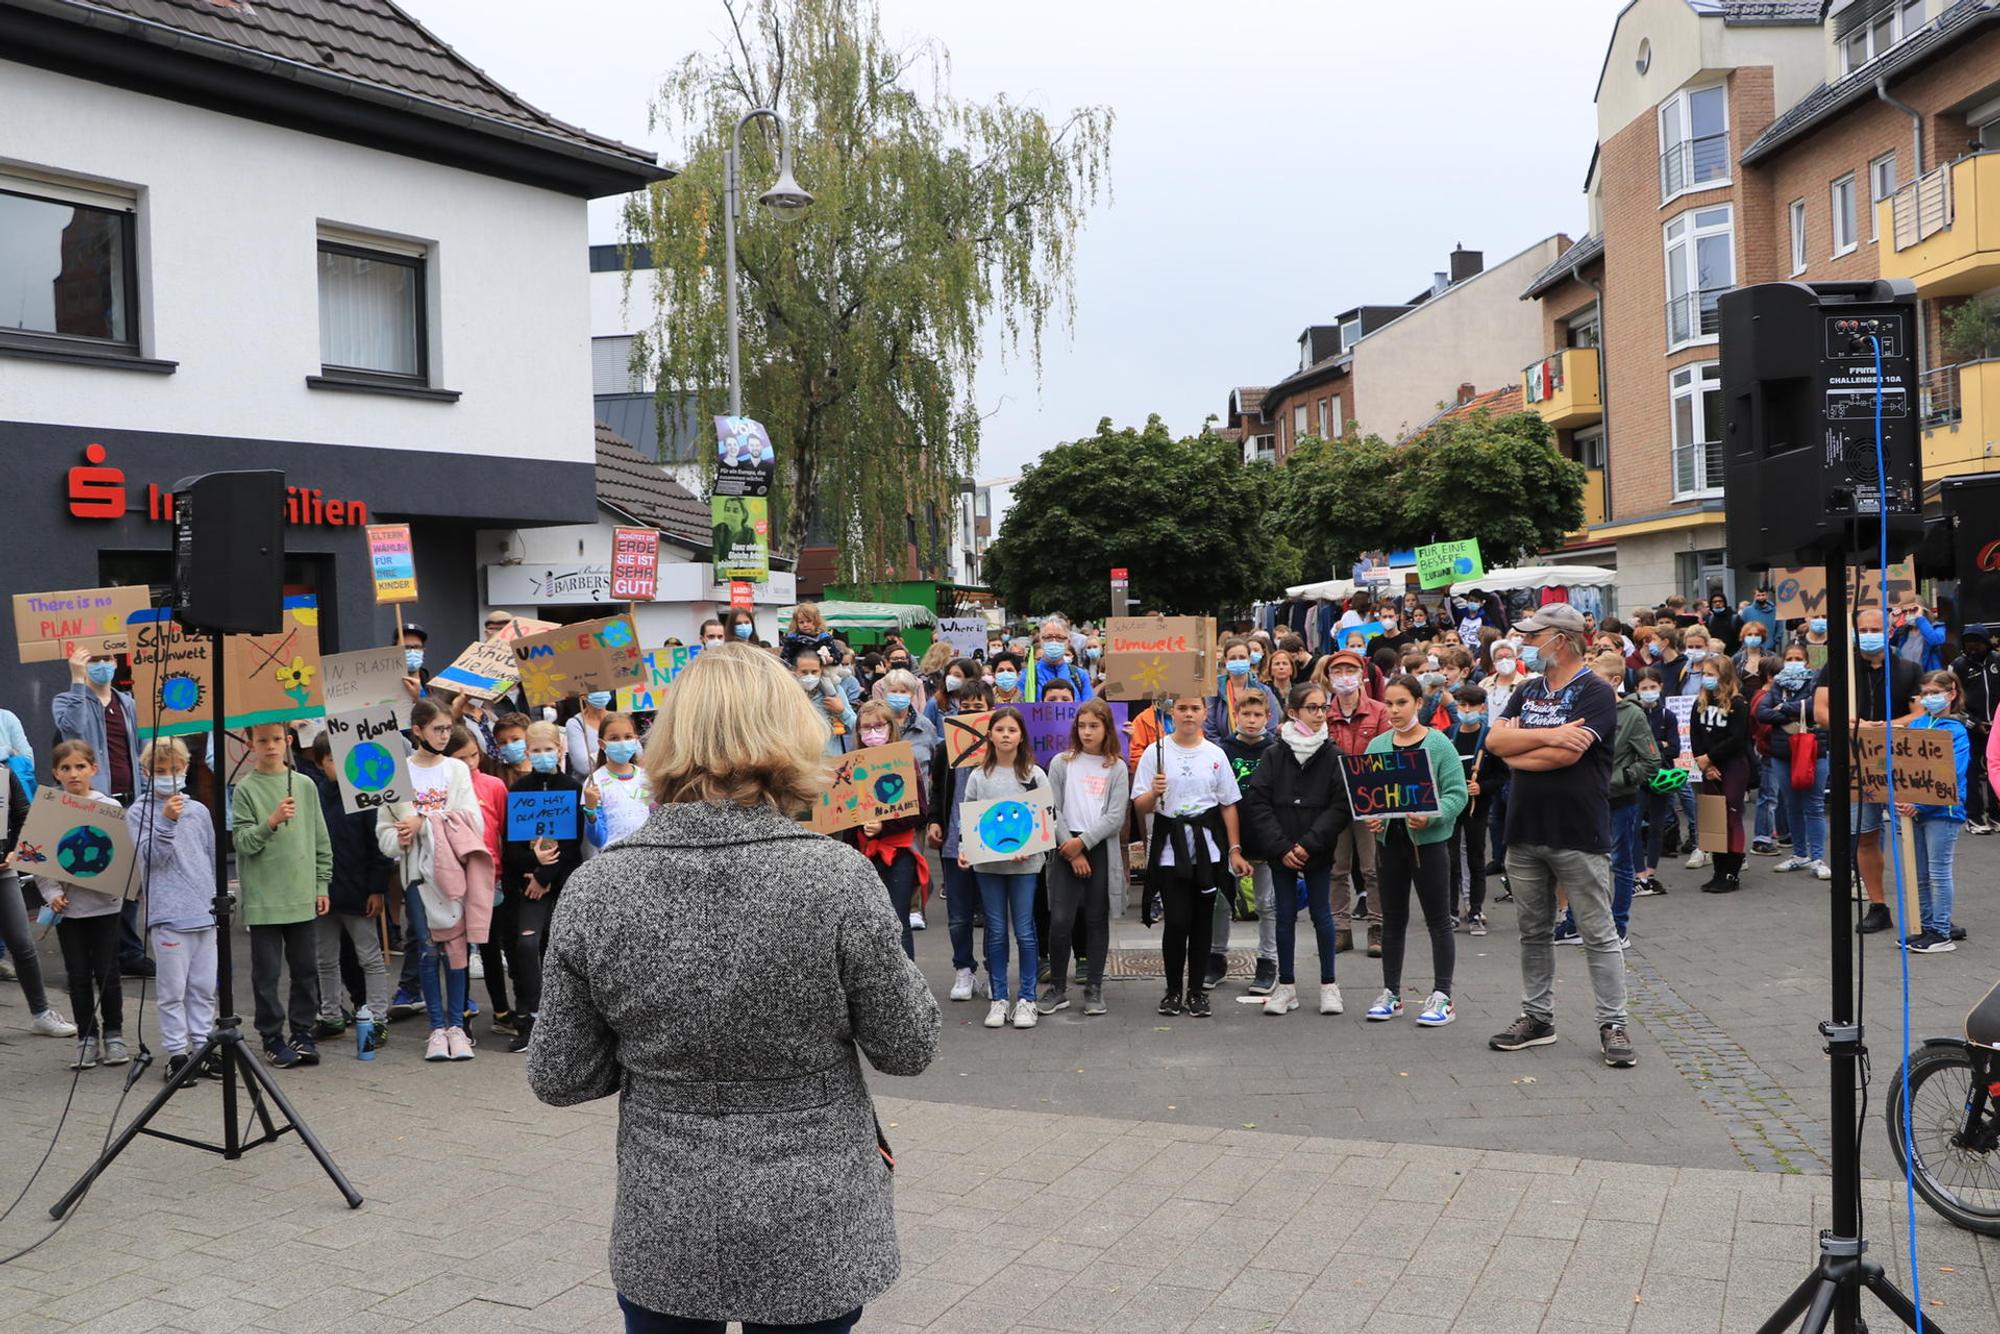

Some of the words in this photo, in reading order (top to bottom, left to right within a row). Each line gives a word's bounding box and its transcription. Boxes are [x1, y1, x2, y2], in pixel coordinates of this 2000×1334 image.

[147, 483, 368, 526] Iilien
[618, 541, 655, 554] ERDE
[1441, 542, 1467, 554] EINE
[616, 555, 634, 565] SIE
[637, 556, 655, 566] IST
[616, 566, 653, 579] SEHR
[378, 580, 410, 590] KINDER
[615, 579, 654, 595] GUT!
[27, 597, 74, 612] There
[77, 595, 90, 609] is
[95, 597, 113, 606] no
[40, 618, 82, 638] PLAN
[940, 621, 973, 632] Where
[1114, 635, 1187, 652] Umwelt
[355, 657, 404, 676] PLASTIK
[327, 681, 359, 699] MEER
[1032, 706, 1075, 720] MEHR
[328, 718, 349, 735] No
[1917, 739, 1944, 760] die
[1347, 751, 1420, 775] UMWELT
[1354, 781, 1436, 813] SCHUTZ
